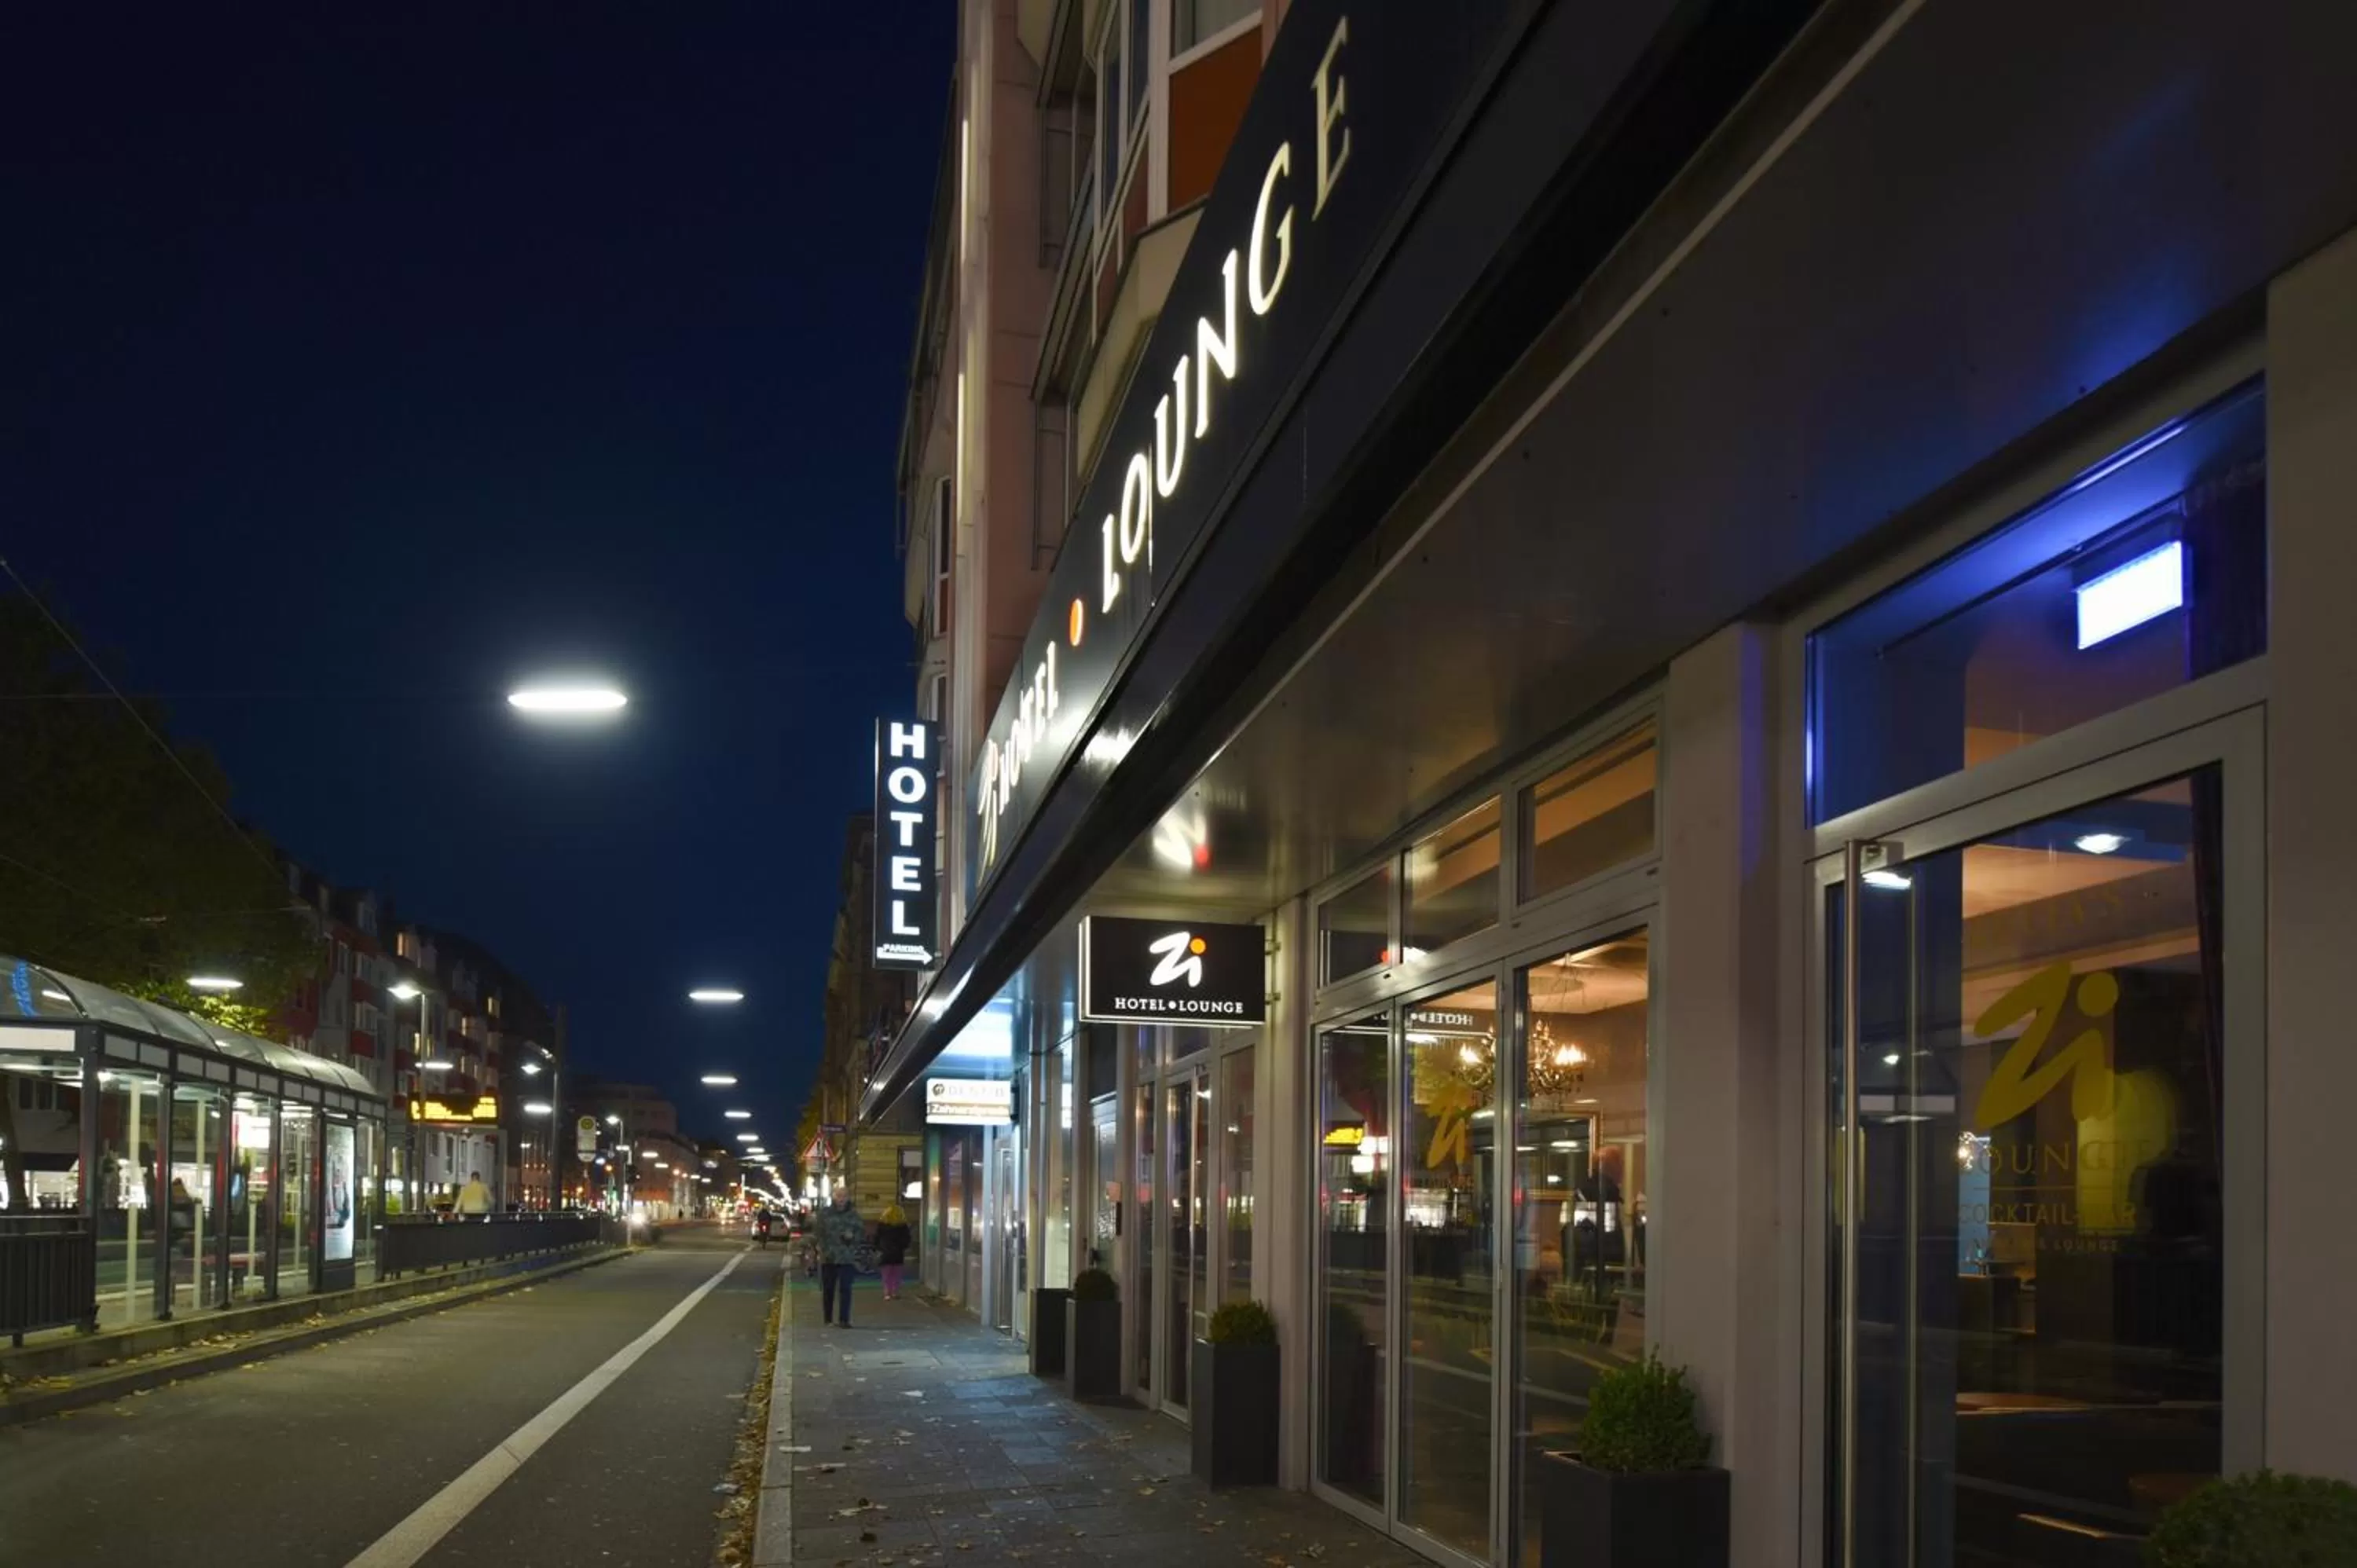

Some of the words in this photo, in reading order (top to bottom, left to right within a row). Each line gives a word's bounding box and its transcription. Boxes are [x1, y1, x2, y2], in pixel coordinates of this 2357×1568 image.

[999, 640, 1058, 815] HOTEL
[1102, 16, 1351, 614] LOUNGE
[888, 722, 926, 935] HOTEL
[1115, 997, 1166, 1011] HOTEL
[1179, 1000, 1244, 1014] LOUNGE
[1959, 1140, 2153, 1175] OUNGE
